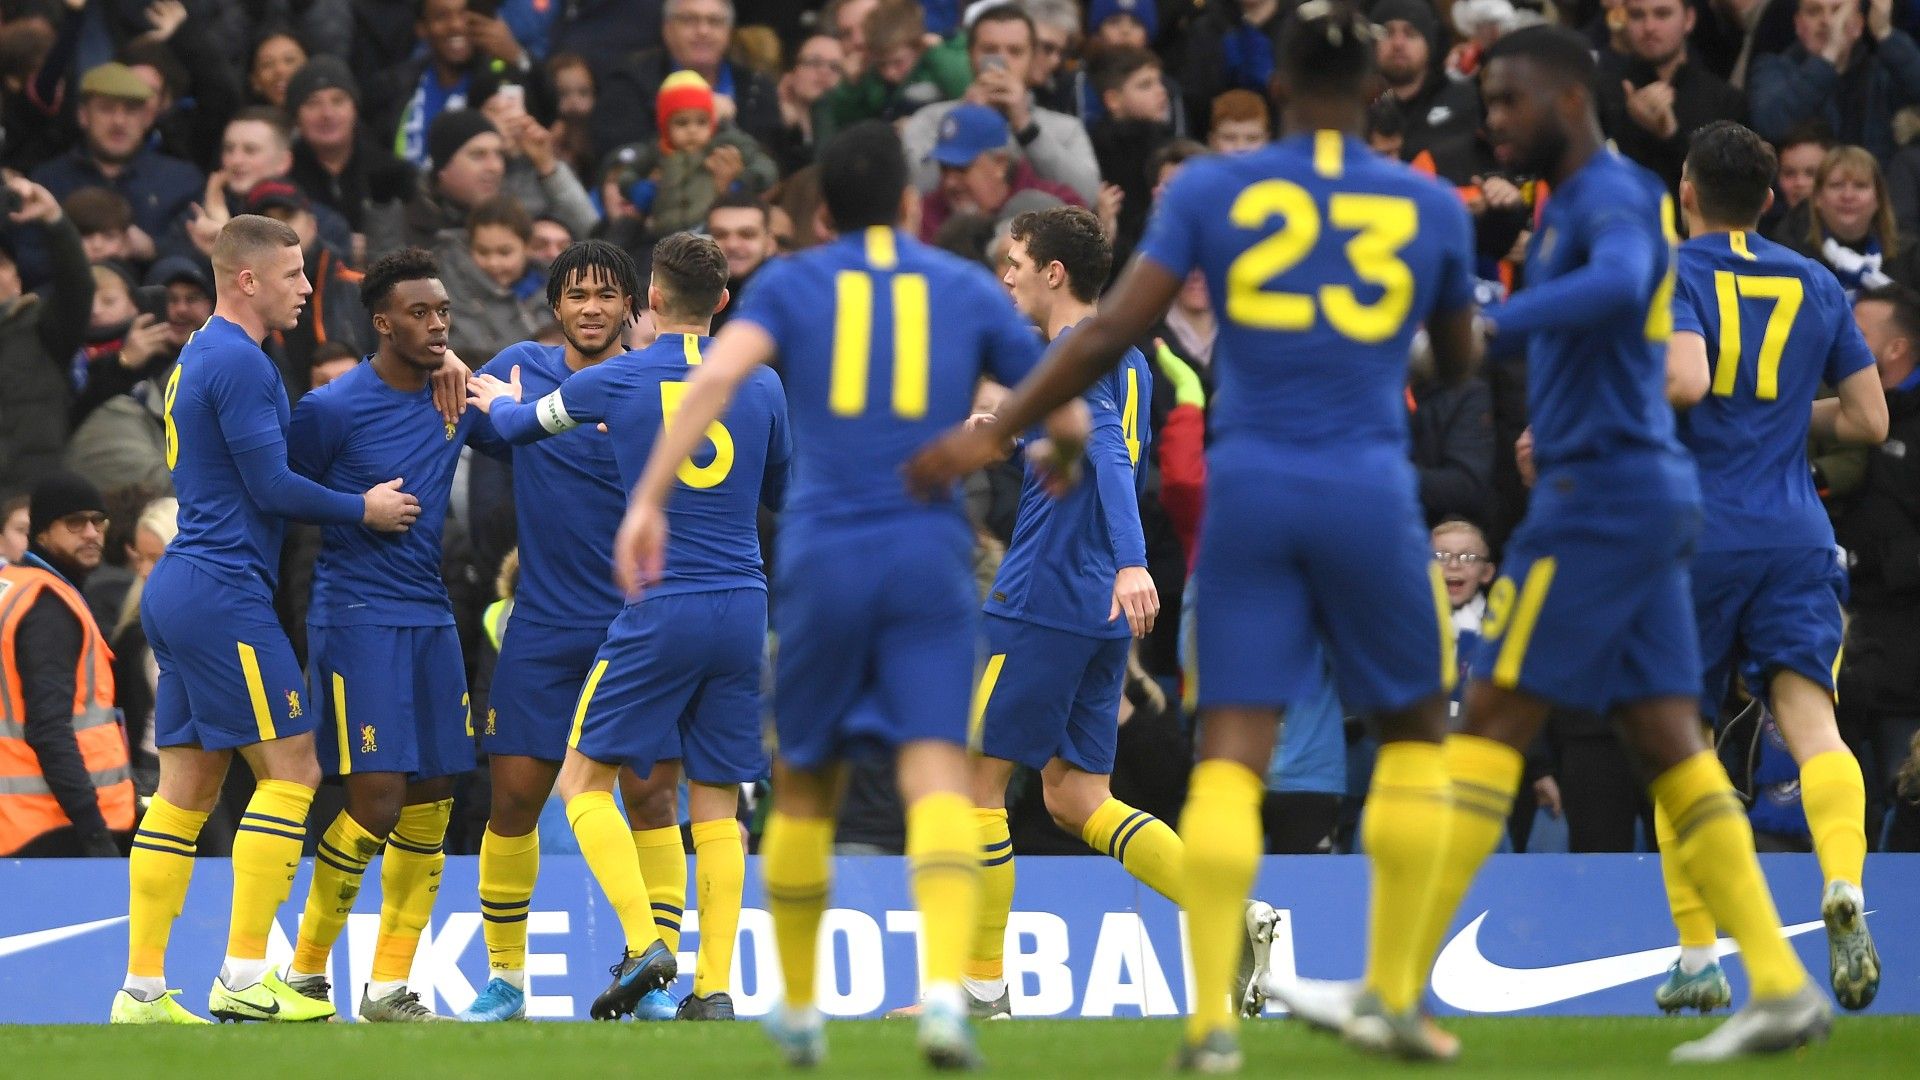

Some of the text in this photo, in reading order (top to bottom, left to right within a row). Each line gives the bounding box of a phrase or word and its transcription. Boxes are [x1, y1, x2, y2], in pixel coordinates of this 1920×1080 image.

[1225, 176, 1420, 345] 23
[828, 268, 931, 420] 11
[1711, 270, 1804, 400] 17
[1121, 367, 1141, 465] 4
[288, 708, 303, 719] CFC
[360, 744, 378, 754] CFC
[491, 961, 509, 969] CFC
[670, 907, 1302, 1016] OOBAL
